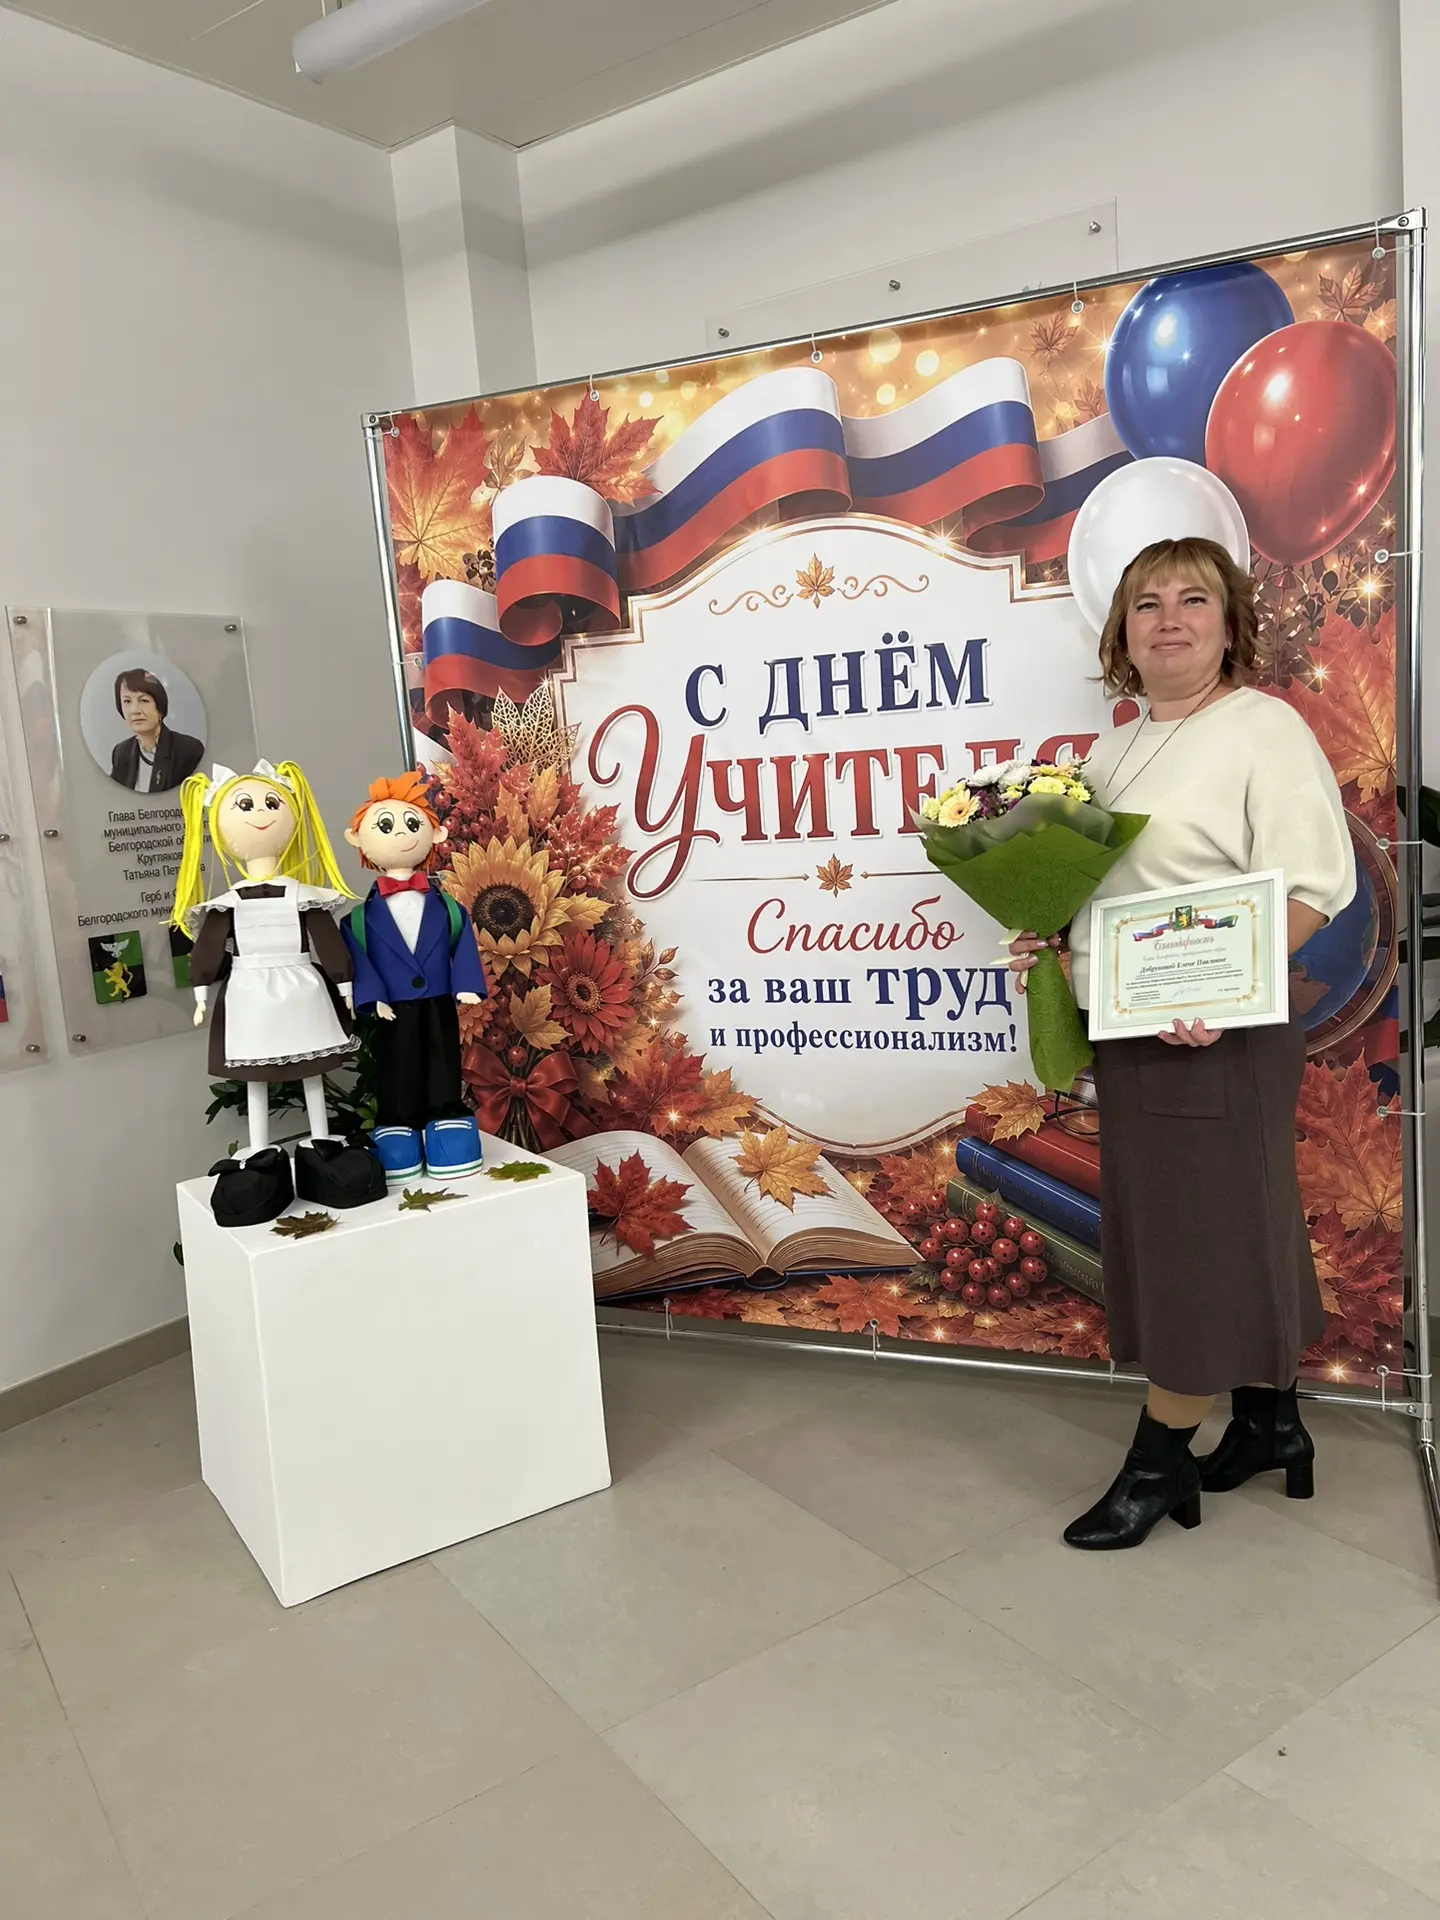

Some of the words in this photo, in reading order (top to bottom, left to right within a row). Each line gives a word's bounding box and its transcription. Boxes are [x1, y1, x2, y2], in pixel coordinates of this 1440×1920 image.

[685, 664, 727, 727] С
[759, 631, 990, 735] ДНЁМ
[588, 699, 1140, 897] УЧИТЕ
[108, 811, 136, 823] Глава
[104, 822, 182, 840] муниципального
[108, 836, 175, 853] Белгородской
[137, 851, 184, 866] Кругляков
[123, 868, 161, 881] Татьяна
[140, 890, 162, 903] Герб
[164, 891, 171, 900] и
[78, 909, 148, 927] Белгородского
[747, 896, 964, 954] Спасибо
[708, 978, 750, 1004] за
[764, 978, 852, 1004] ваш
[866, 966, 1013, 1021] труд
[710, 1028, 727, 1047] и
[735, 1020, 1017, 1056] профессионализм!
